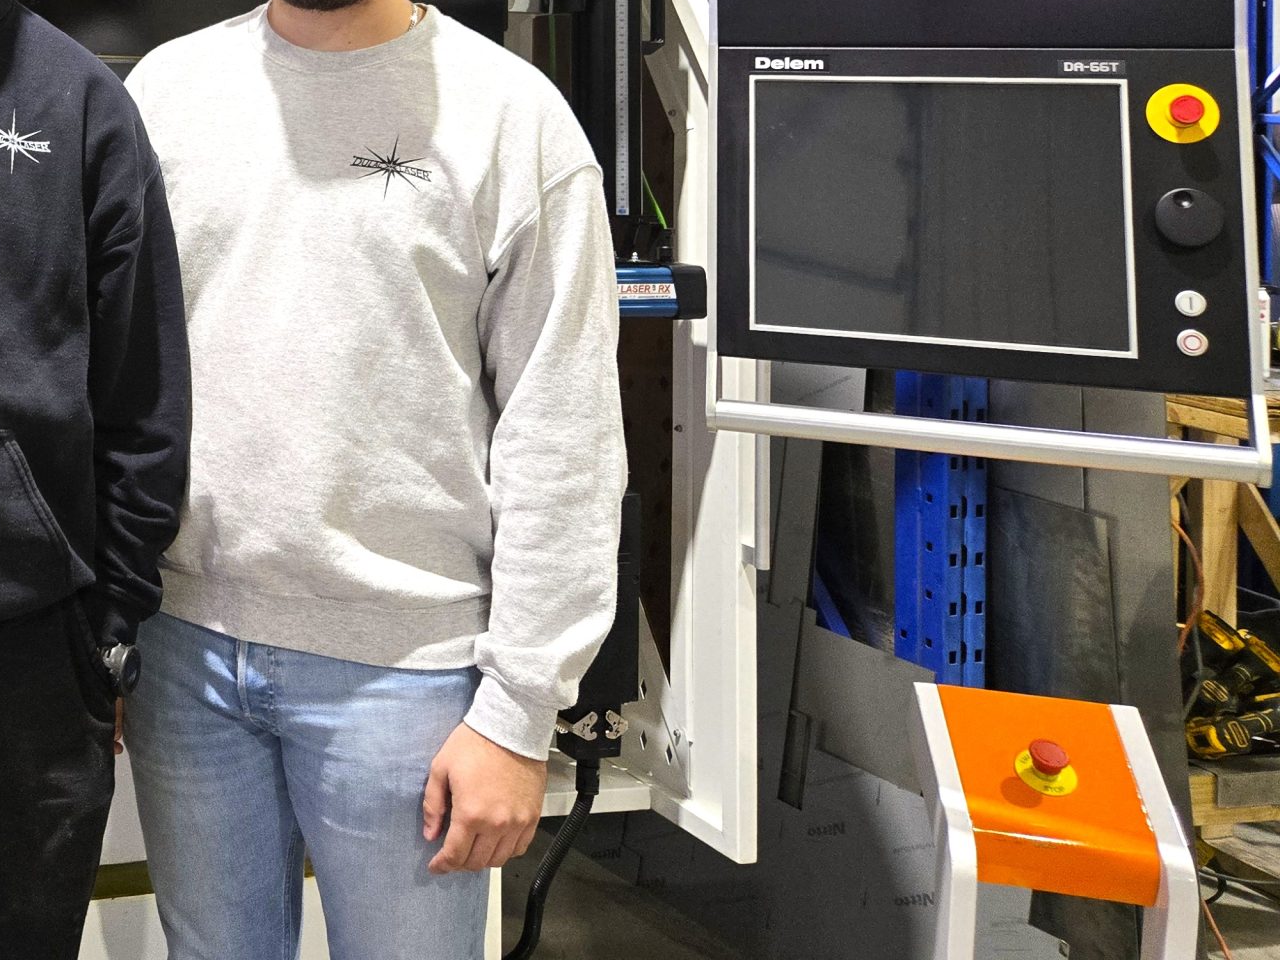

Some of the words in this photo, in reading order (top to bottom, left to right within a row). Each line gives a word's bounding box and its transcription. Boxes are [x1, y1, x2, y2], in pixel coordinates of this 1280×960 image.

[754, 56, 824, 70] Delem
[1063, 61, 1119, 72] DA-66T
[399, 166, 432, 182] LASER
[620, 284, 650, 293] LASER
[658, 284, 671, 293] RX
